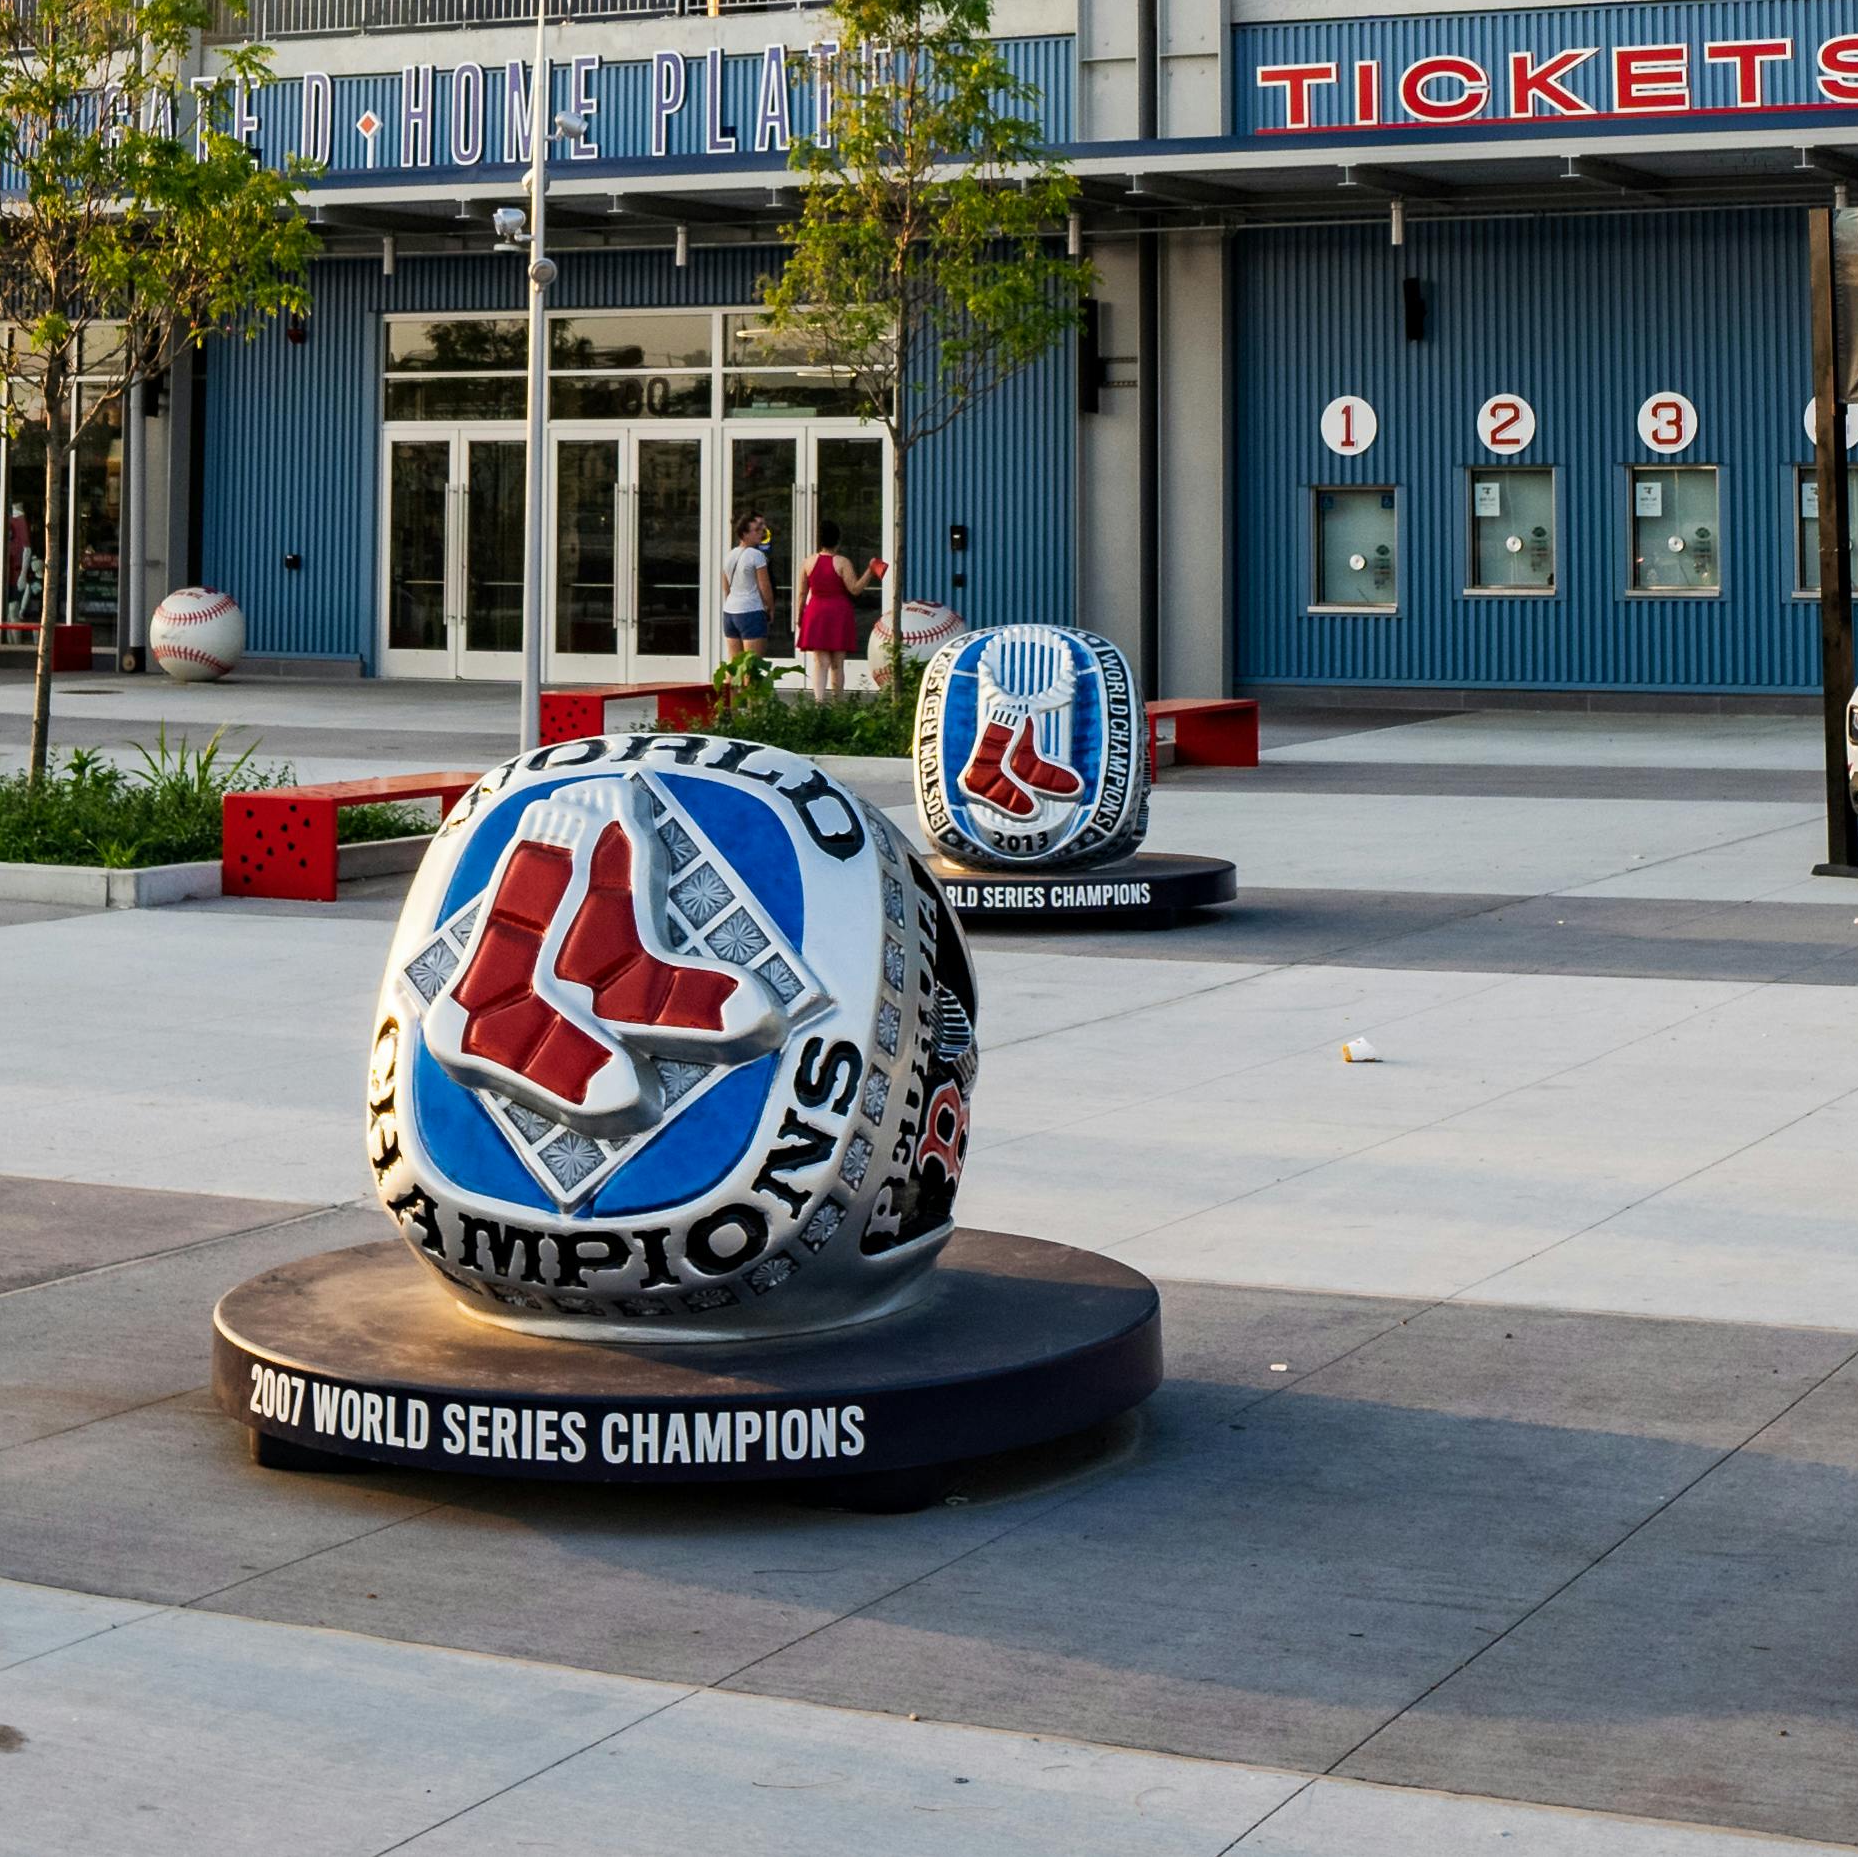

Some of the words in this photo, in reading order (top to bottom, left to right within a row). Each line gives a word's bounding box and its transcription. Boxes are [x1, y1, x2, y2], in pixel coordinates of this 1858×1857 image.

[300, 71, 334, 172] D
[400, 54, 601, 168] HOME
[1340, 403, 1357, 448] 1
[1488, 401, 1522, 446] 2
[1650, 401, 1684, 446] 3
[924, 652, 955, 691] SOX
[1099, 649, 1129, 716] WORLD
[920, 695, 941, 741] RED
[919, 742, 949, 833] BOSTON
[1094, 718, 1130, 830] CHAMPIONS
[992, 830, 1050, 852] 2013
[946, 885, 978, 909] RLD
[982, 884, 1046, 909] SERIES
[1049, 882, 1152, 909] CHAMPIONS
[249, 1363, 308, 1426] 2007
[311, 1381, 430, 1451] WORLD
[442, 1402, 588, 1465] SERIES
[600, 1404, 867, 1465] CHAMPIONS
